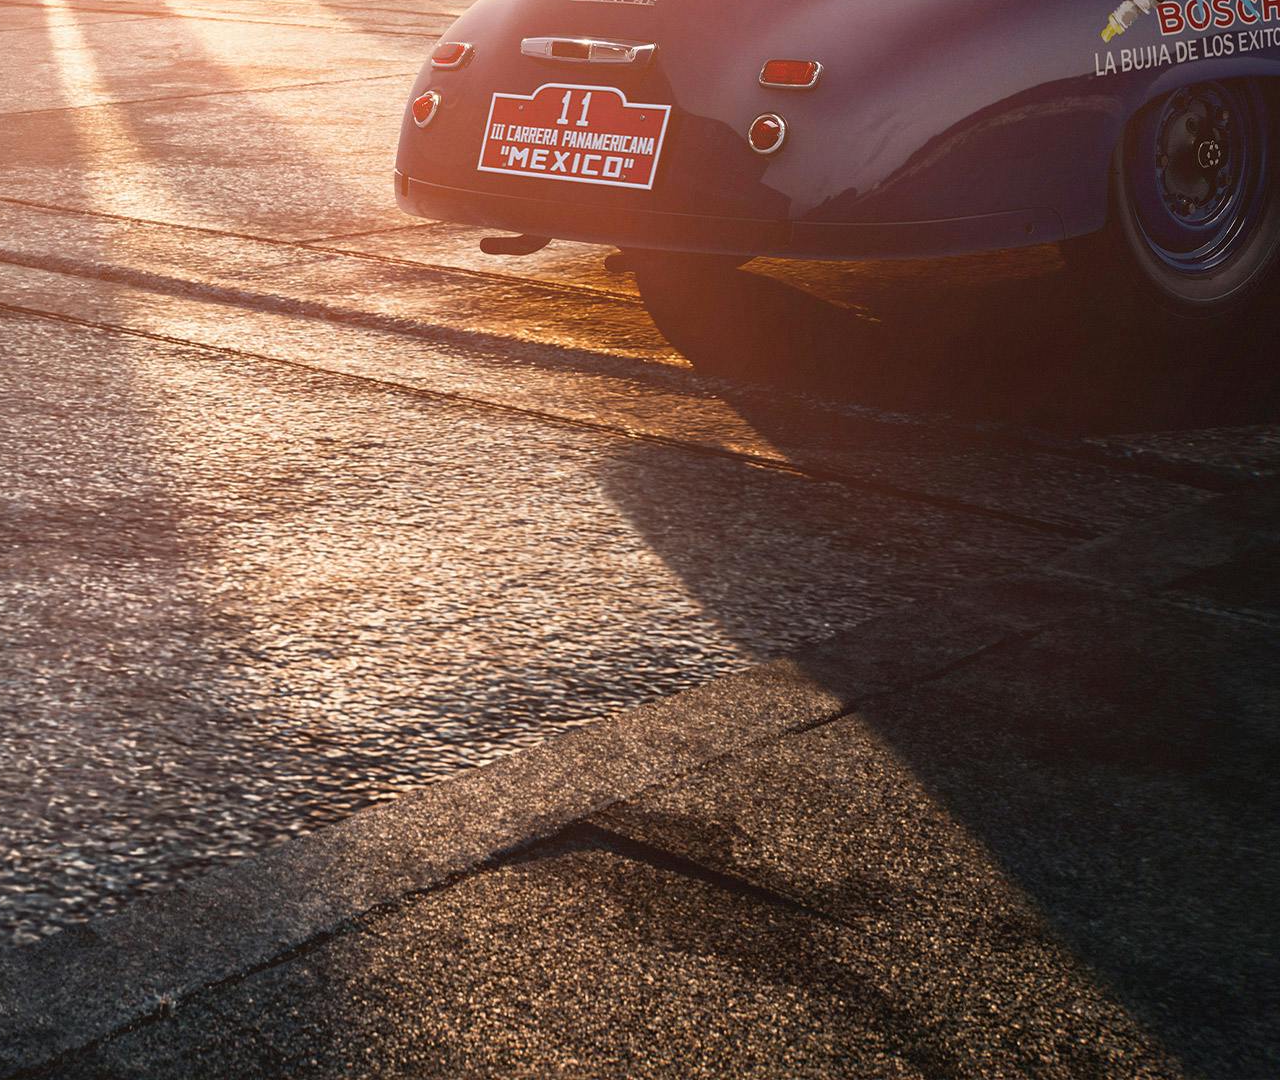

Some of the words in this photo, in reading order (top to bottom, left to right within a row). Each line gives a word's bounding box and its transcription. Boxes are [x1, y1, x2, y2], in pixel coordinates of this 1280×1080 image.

[1094, 51, 1117, 76] LA
[1120, 42, 1172, 73] BUJIA
[1175, 39, 1199, 64] DE
[1202, 32, 1235, 59] LOS
[556, 90, 592, 127] 11
[490, 123, 505, 141] III
[506, 125, 559, 147] CARRERA
[561, 130, 656, 156] PANAMERICANA
[500, 145, 635, 179] "MEXICO"
